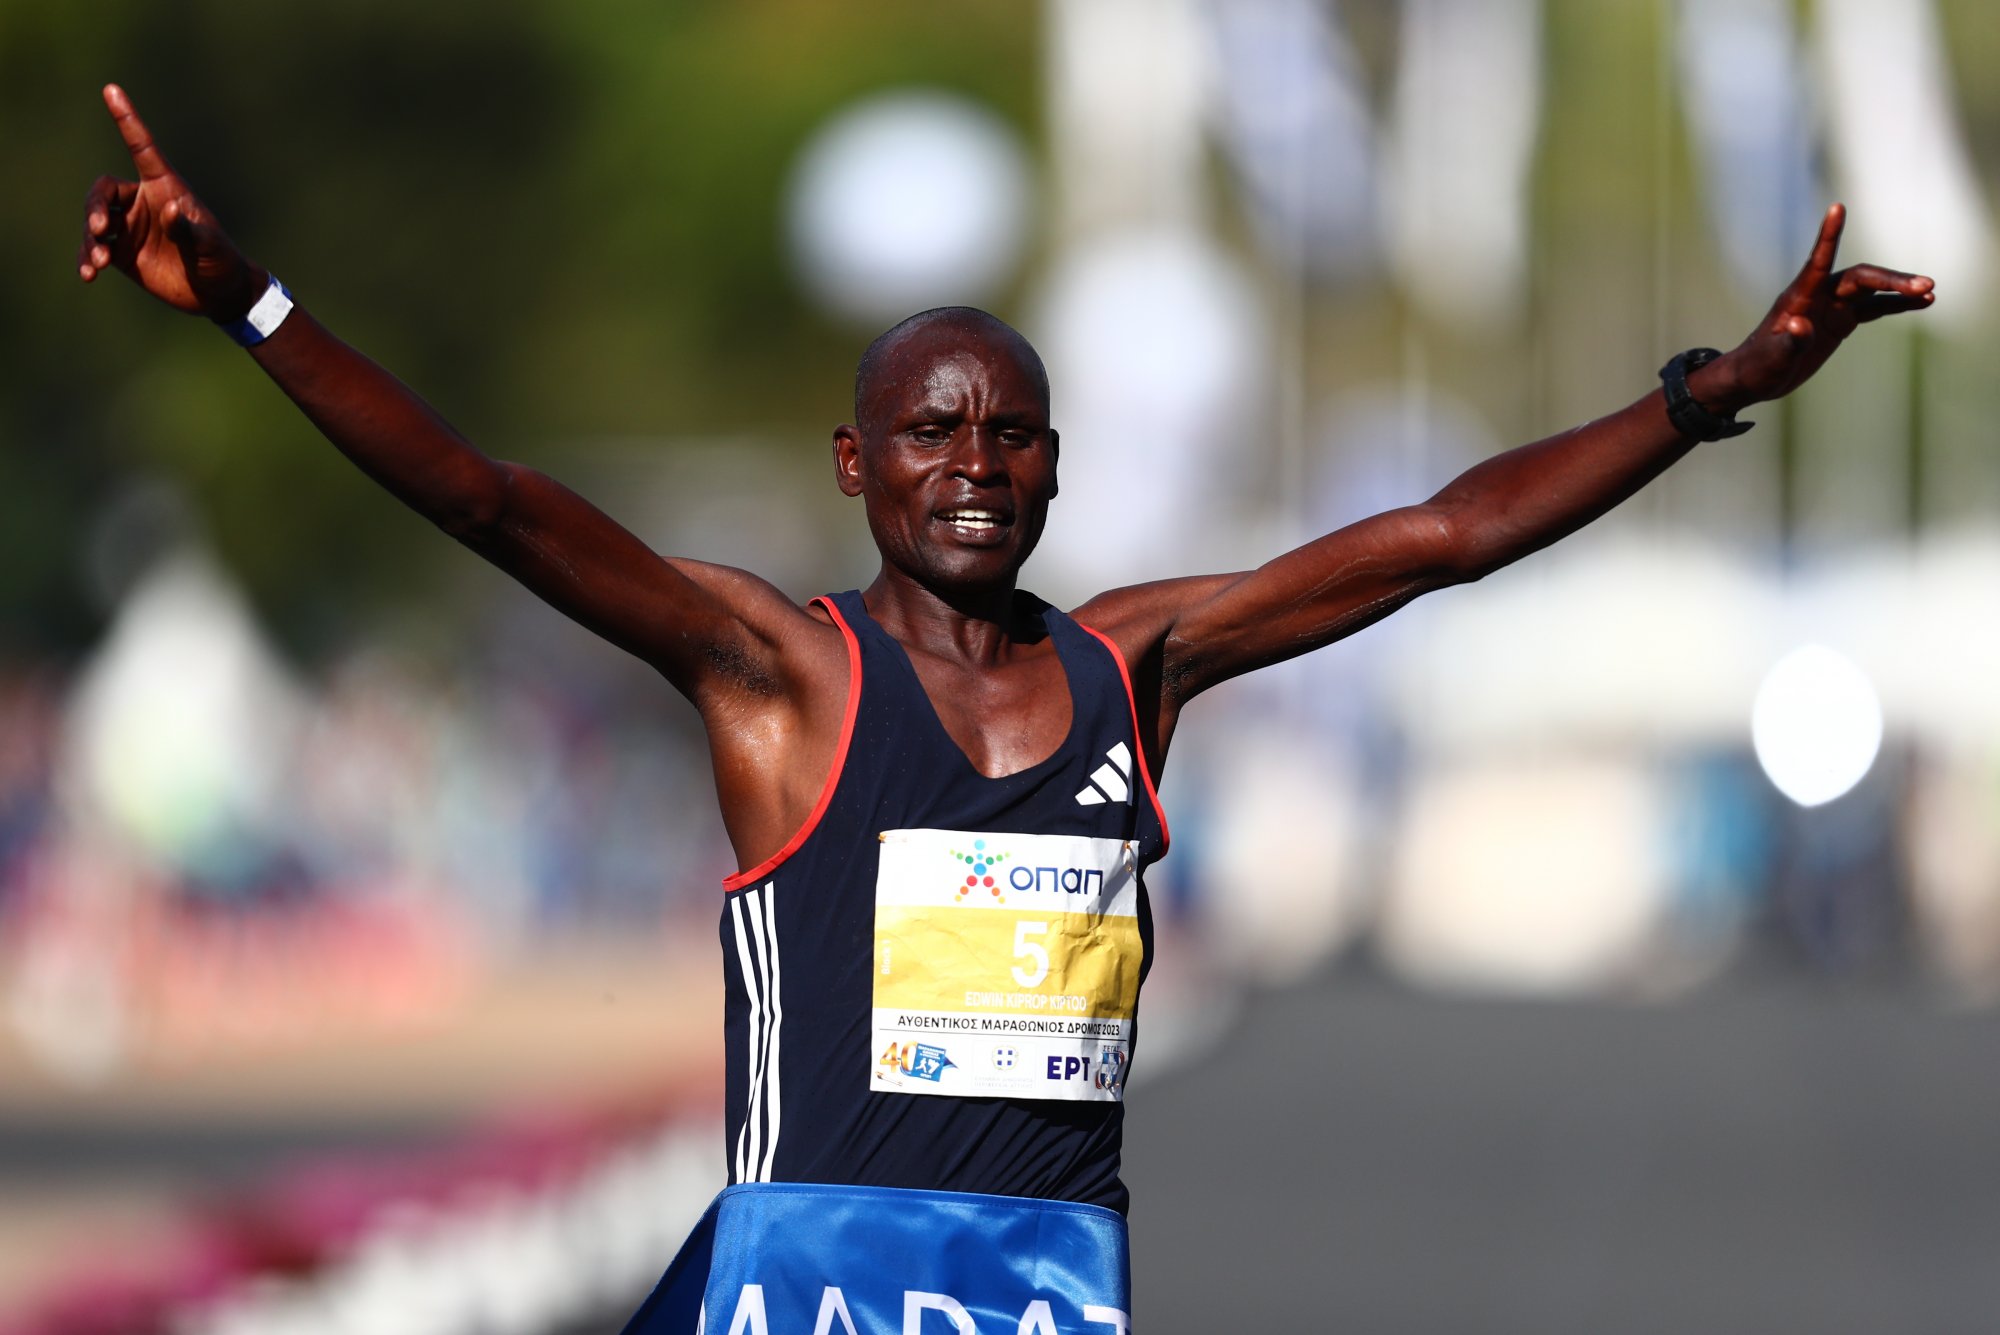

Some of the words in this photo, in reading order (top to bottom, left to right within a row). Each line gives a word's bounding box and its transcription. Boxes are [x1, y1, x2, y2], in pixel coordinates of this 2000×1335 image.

[1011, 920, 1049, 988] 5
[965, 991, 1003, 1007] EDWIN
[1006, 993, 1047, 1010] KIPROP
[897, 1015, 978, 1030] ΑΥΘΕΝΤΙΚΟΣ
[981, 1019, 1064, 1033] ΜΑΡΑΘΩΝΙΟΣ
[1102, 1024, 1120, 1036] 2023
